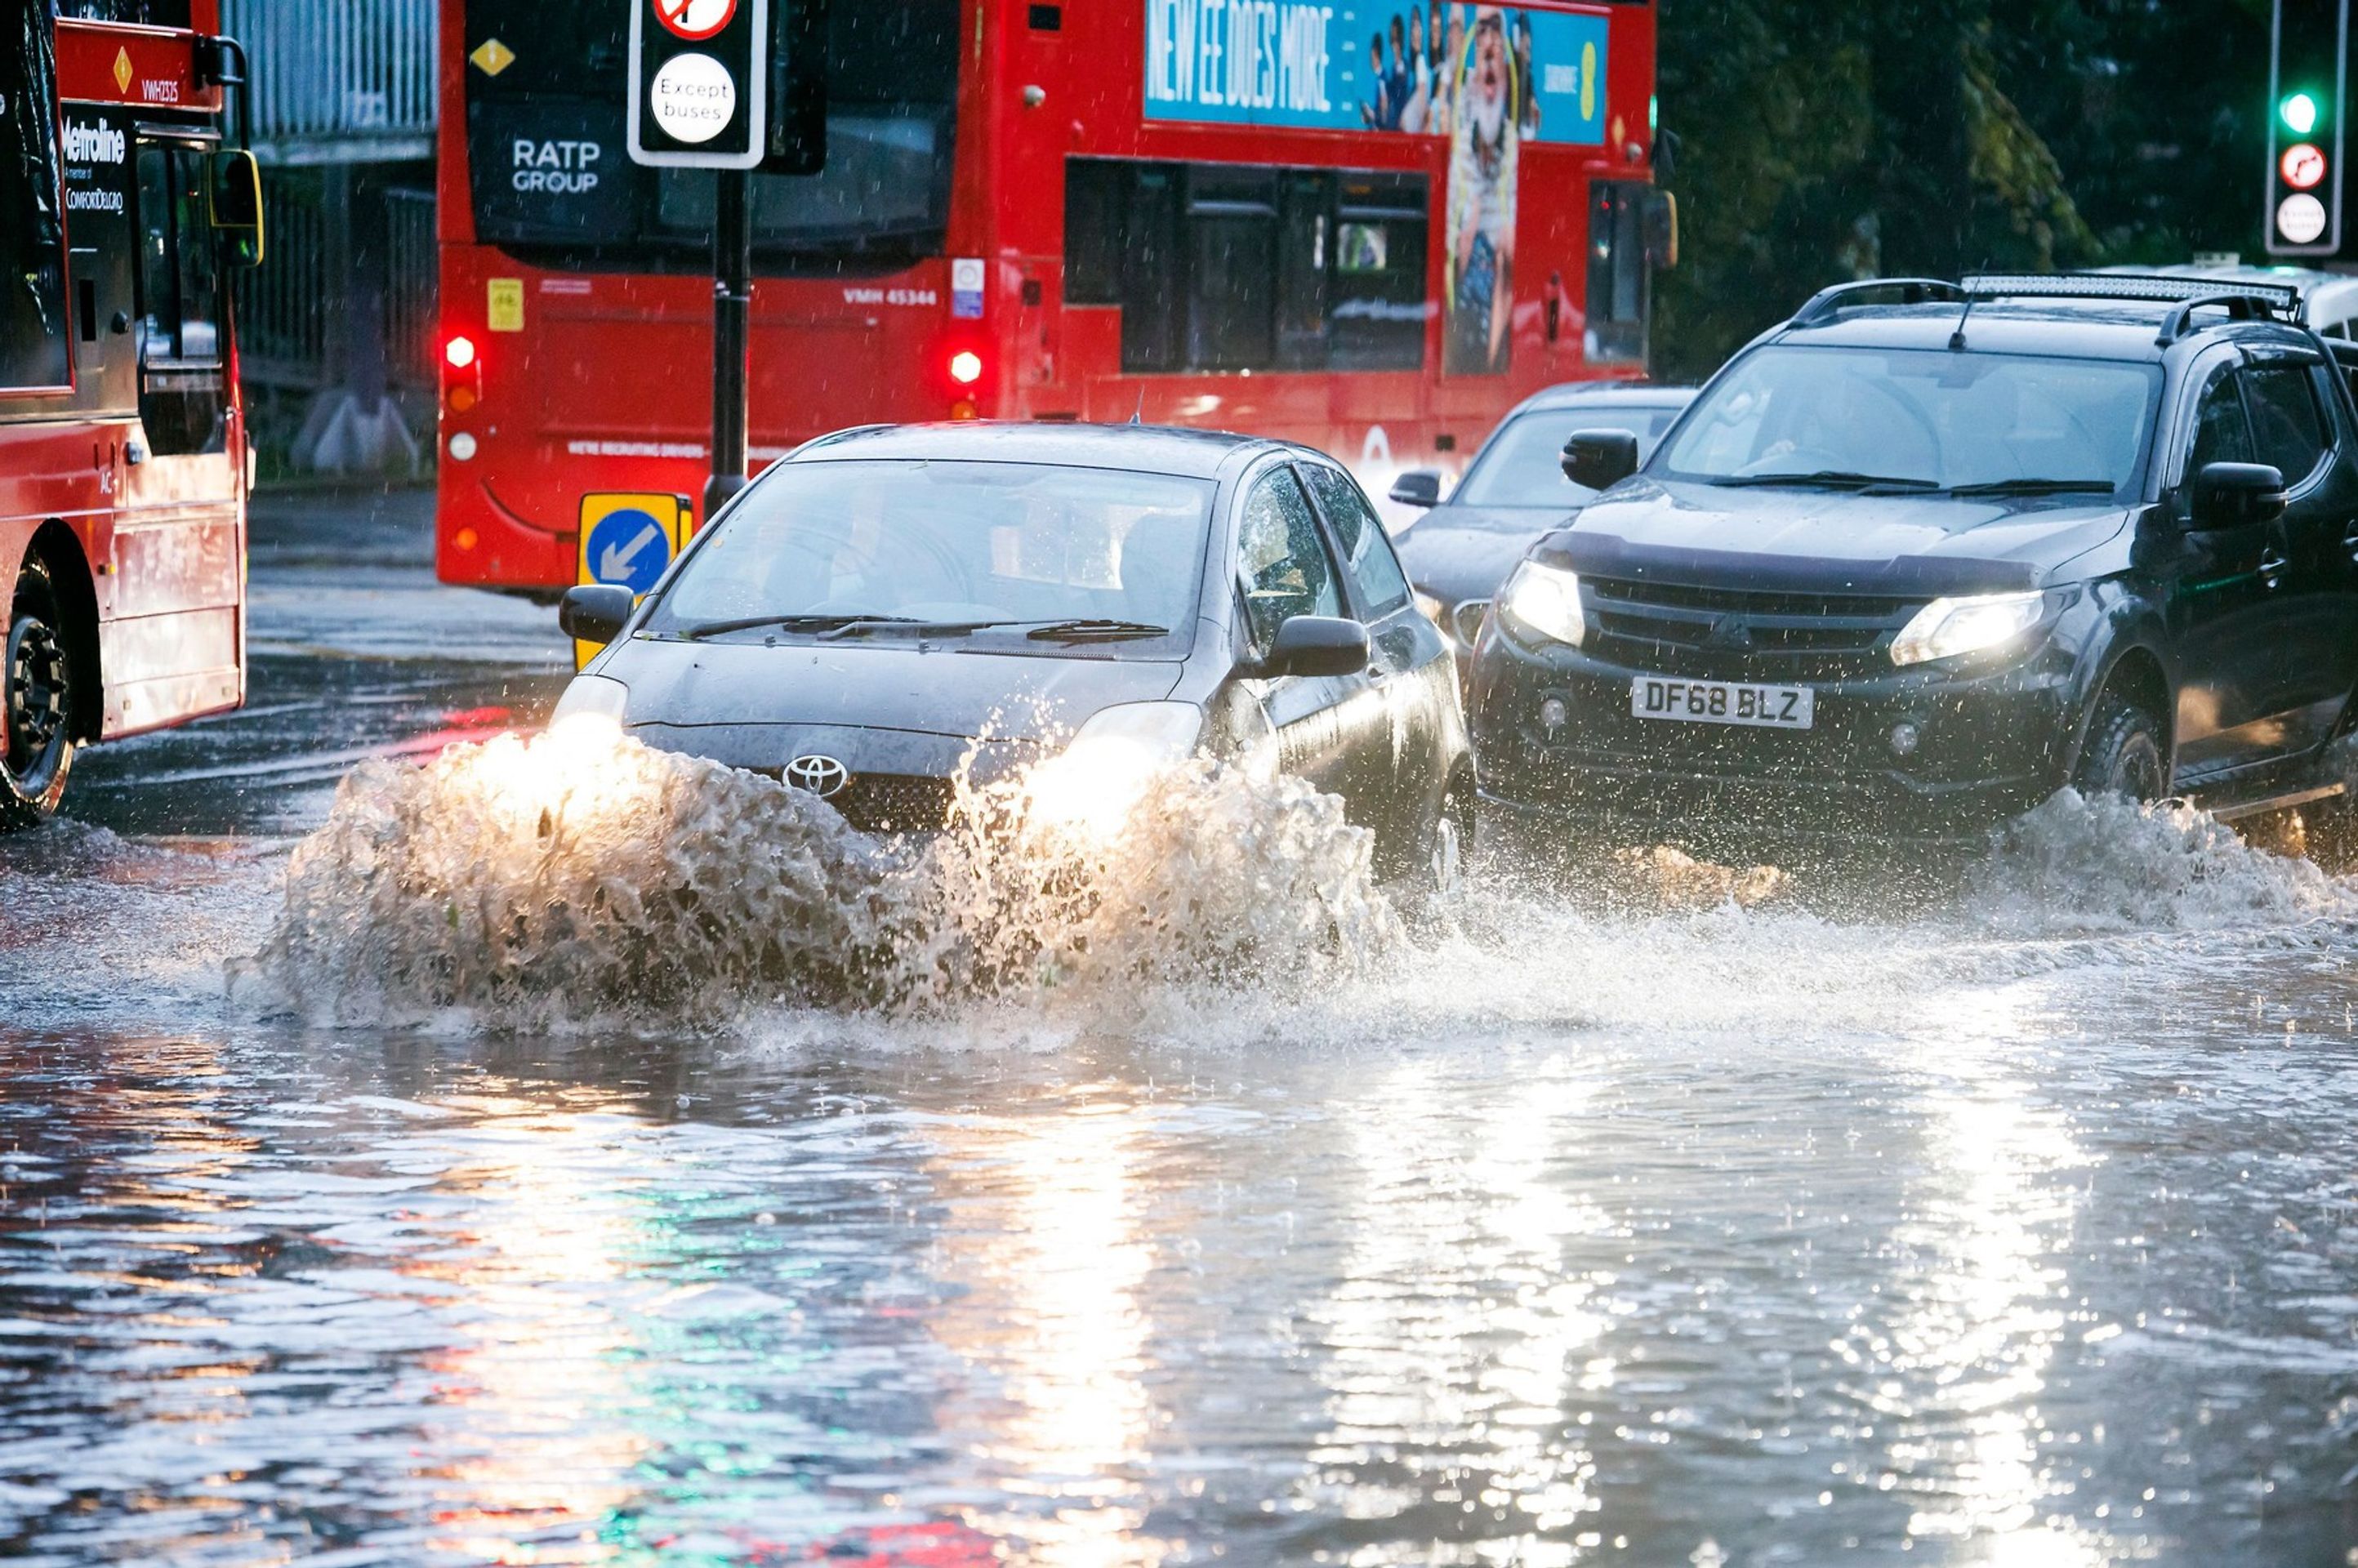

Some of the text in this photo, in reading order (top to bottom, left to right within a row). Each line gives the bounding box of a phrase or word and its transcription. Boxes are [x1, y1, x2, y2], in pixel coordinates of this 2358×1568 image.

[1148, 0, 1197, 102] NEW
[1198, 0, 1225, 105] EE
[1226, 1, 1277, 109] DOES
[1279, 3, 1333, 113] MORE
[661, 78, 729, 100] Except
[665, 101, 721, 120] buses
[60, 115, 125, 164] Metroline
[513, 140, 600, 170] RATP
[512, 170, 599, 194] GROUP
[1645, 681, 1799, 722] DF68 BLZ
